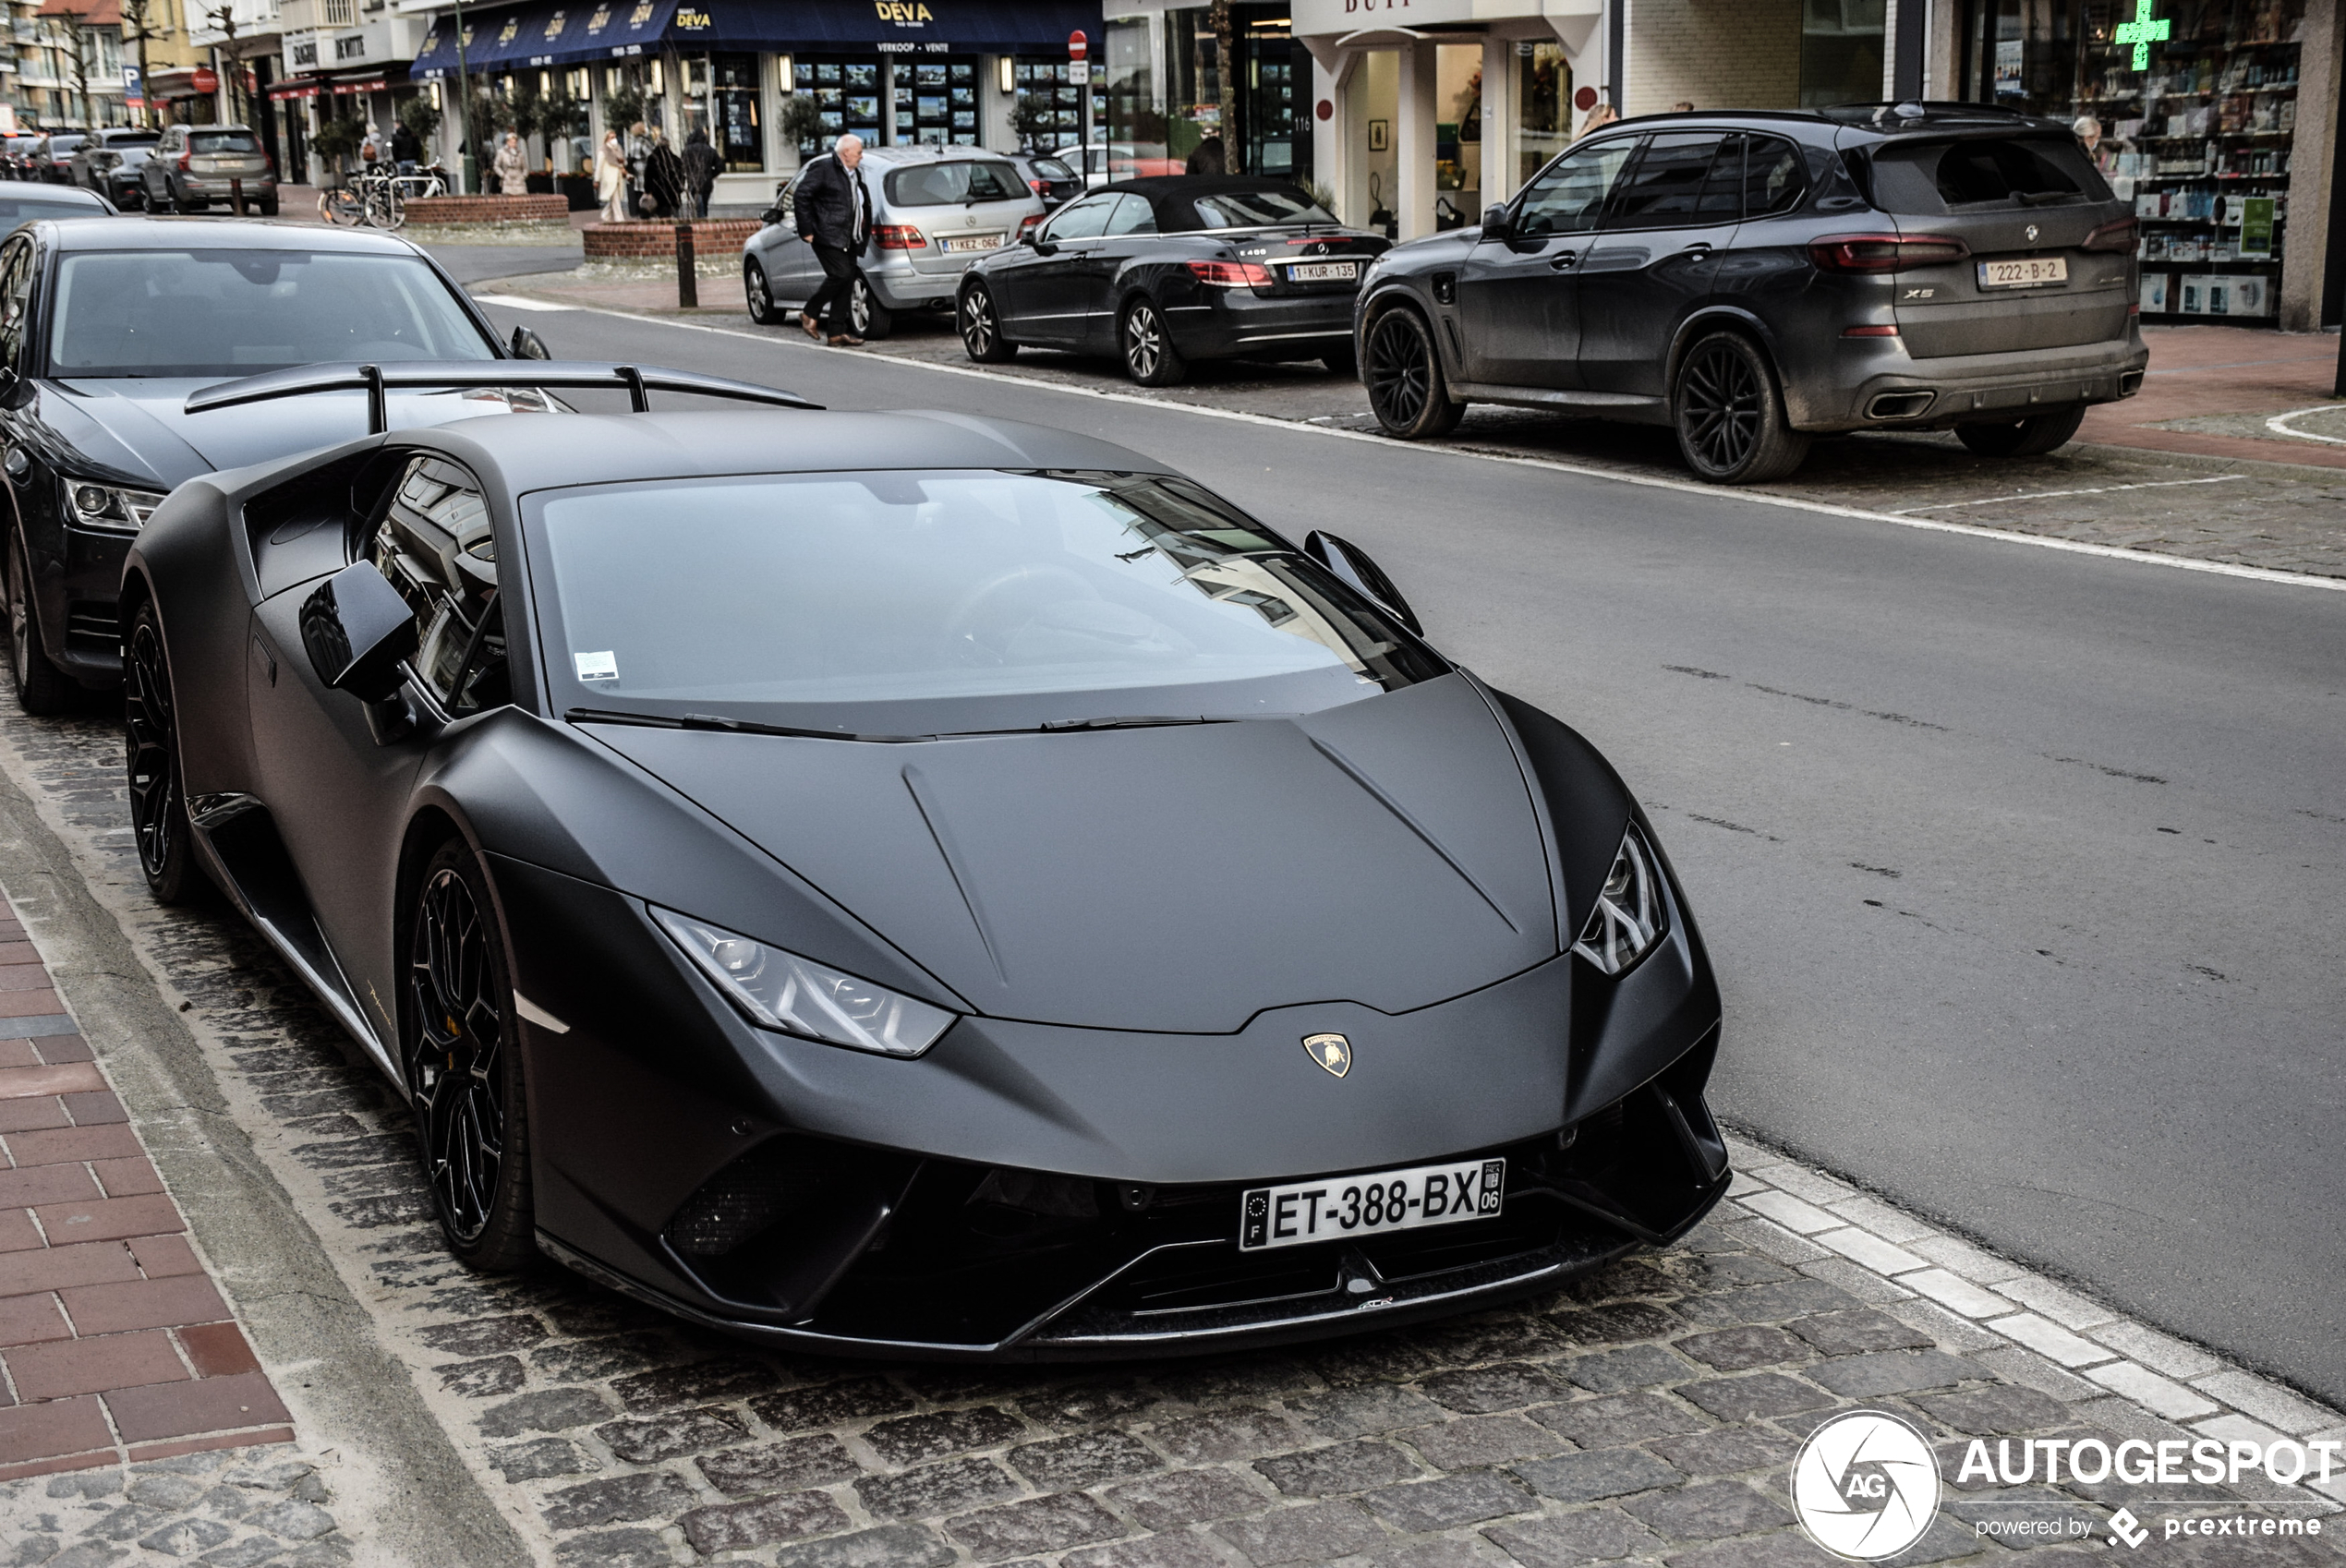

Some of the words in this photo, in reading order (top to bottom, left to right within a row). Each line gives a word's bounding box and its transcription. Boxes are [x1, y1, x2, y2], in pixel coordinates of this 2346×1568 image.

[875, 2, 933, 21] DEVA
[677, 14, 710, 27] DEVA
[925, 42, 949, 53] VENTE
[124, 68, 139, 88] P
[1294, 116, 1311, 132] 116
[1903, 288, 1935, 299] X5
[1274, 1170, 1478, 1238] ET-388-BX
[1481, 1190, 1499, 1210] 06
[1251, 1224, 1261, 1238] F
